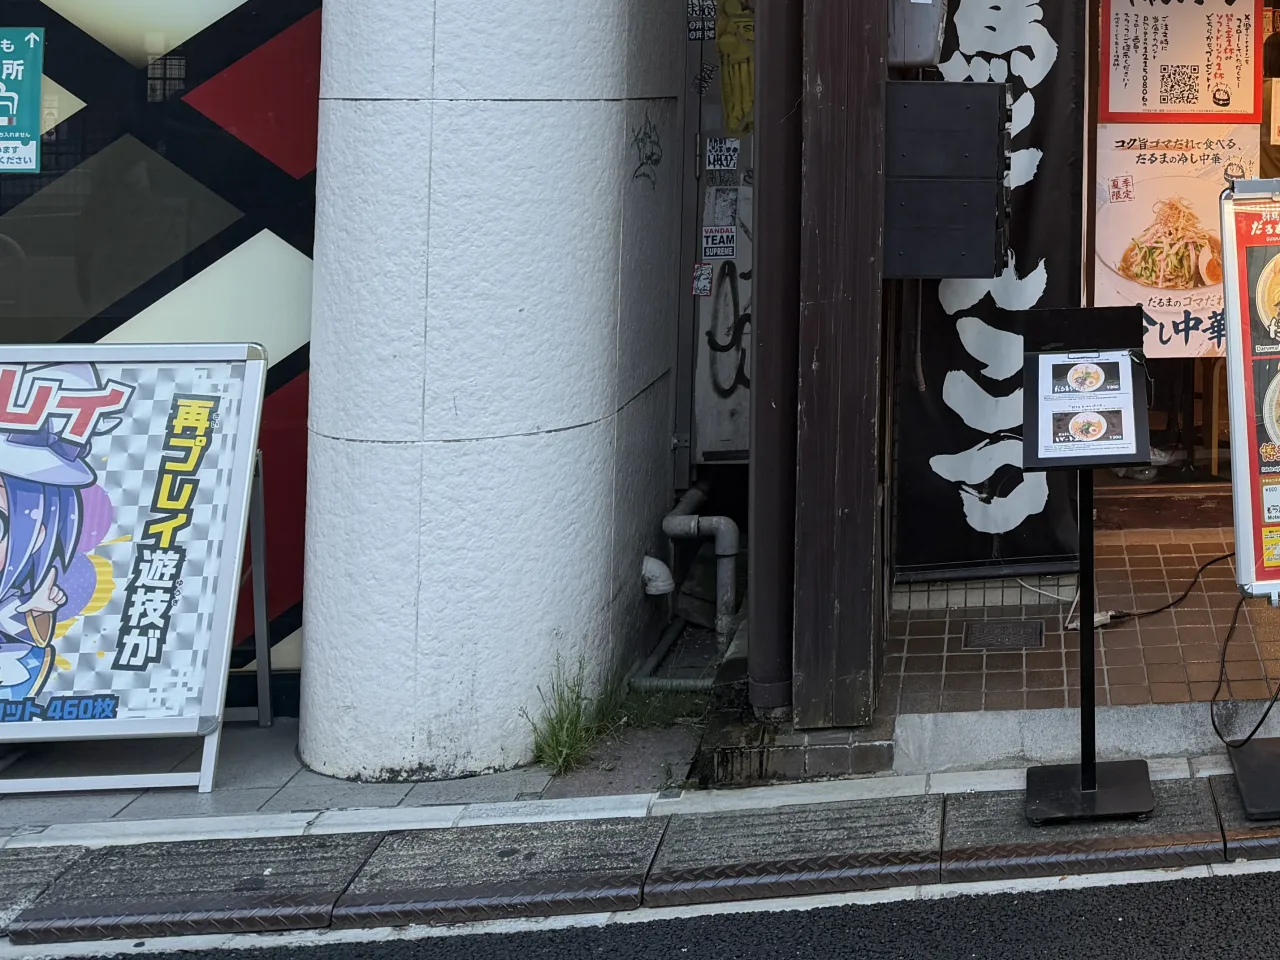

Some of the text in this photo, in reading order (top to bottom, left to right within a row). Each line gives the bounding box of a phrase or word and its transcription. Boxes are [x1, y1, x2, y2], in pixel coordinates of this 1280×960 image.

[1135, 152, 1223, 165] だるまの冷し中華
[704, 235, 735, 246] TEAM
[705, 246, 734, 256] SUPREME
[119, 397, 215, 668] 再プレイ遊技が
[47, 696, 116, 719] 460枚
